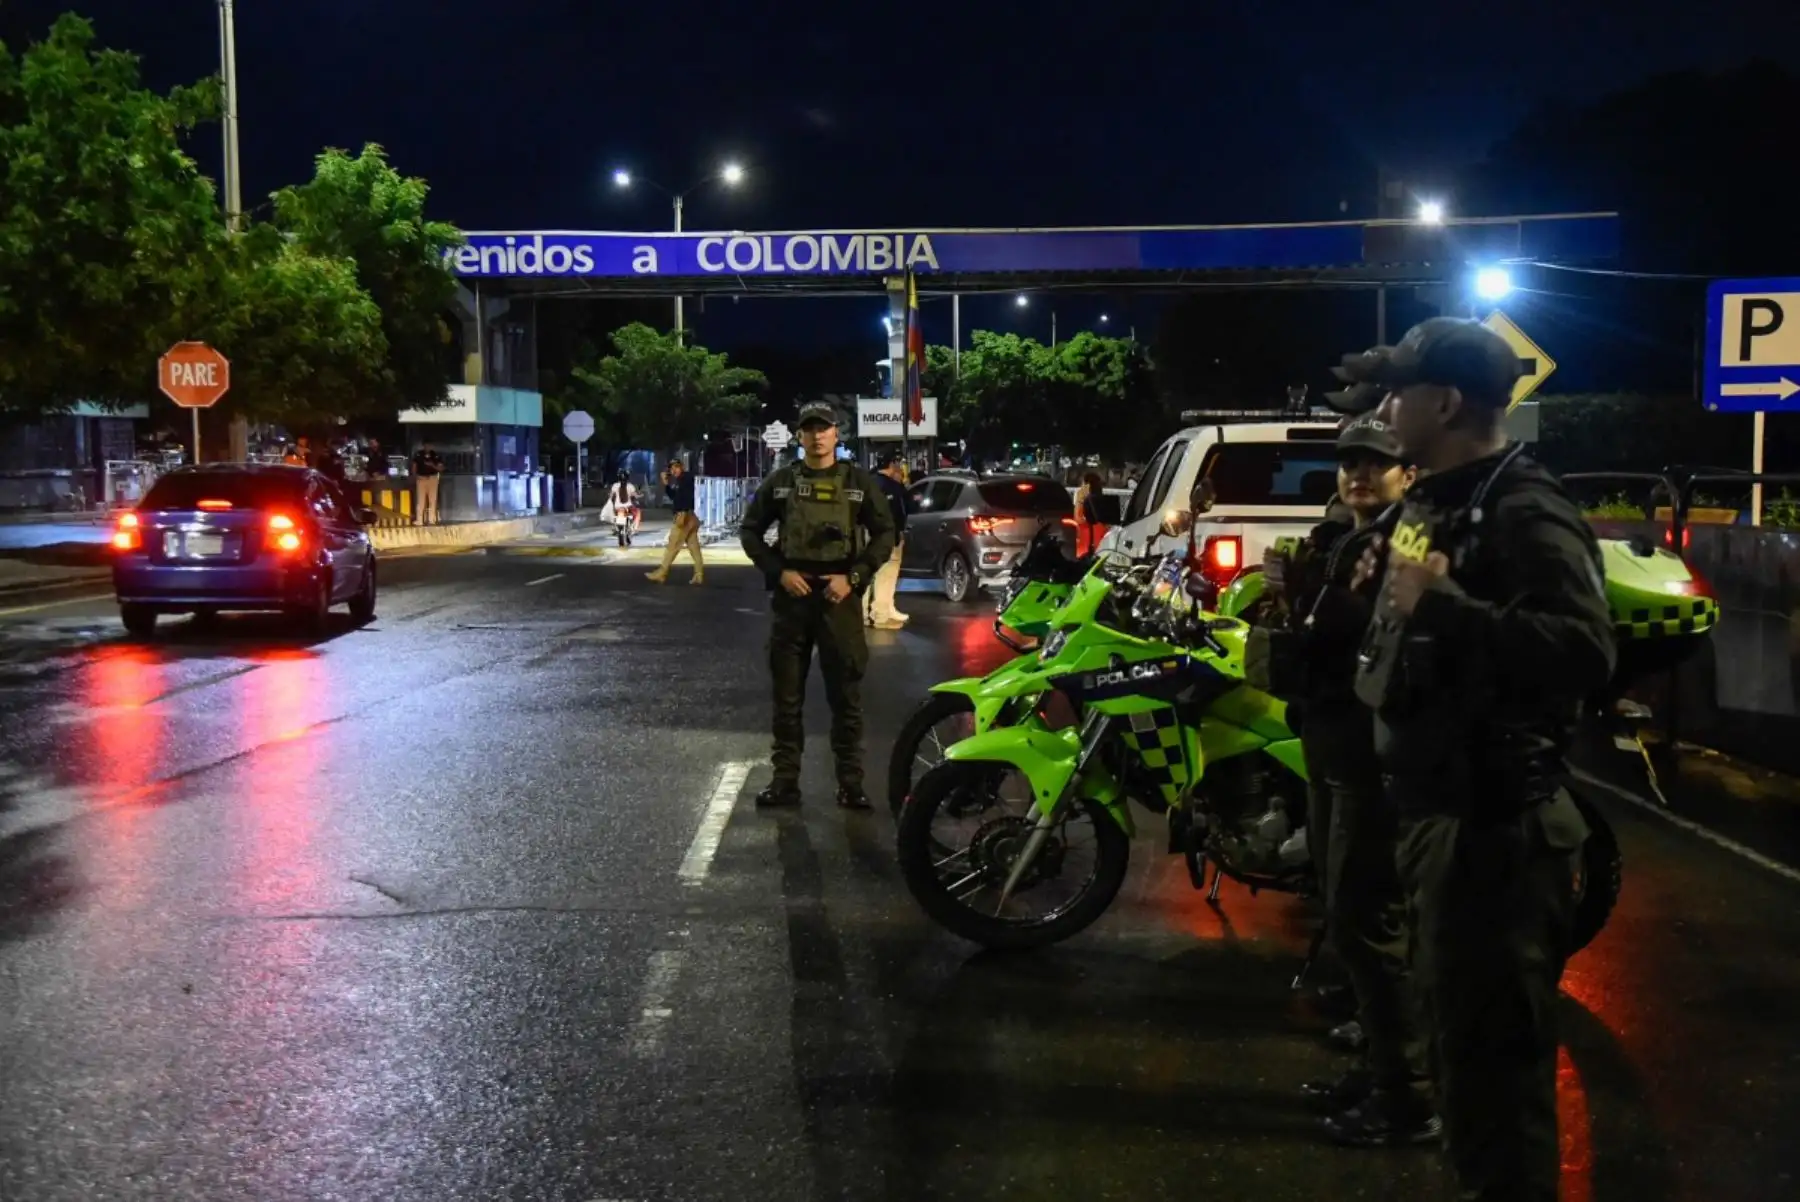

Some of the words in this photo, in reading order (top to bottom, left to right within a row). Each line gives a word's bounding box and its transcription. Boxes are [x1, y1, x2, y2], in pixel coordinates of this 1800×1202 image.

[632, 244, 658, 273] a
[697, 234, 940, 272] COLOMBIA
[1739, 298, 1784, 361] P
[171, 362, 219, 386] PARE
[863, 412, 926, 422] MIGRACN
[1096, 661, 1162, 688] POLCÍA
